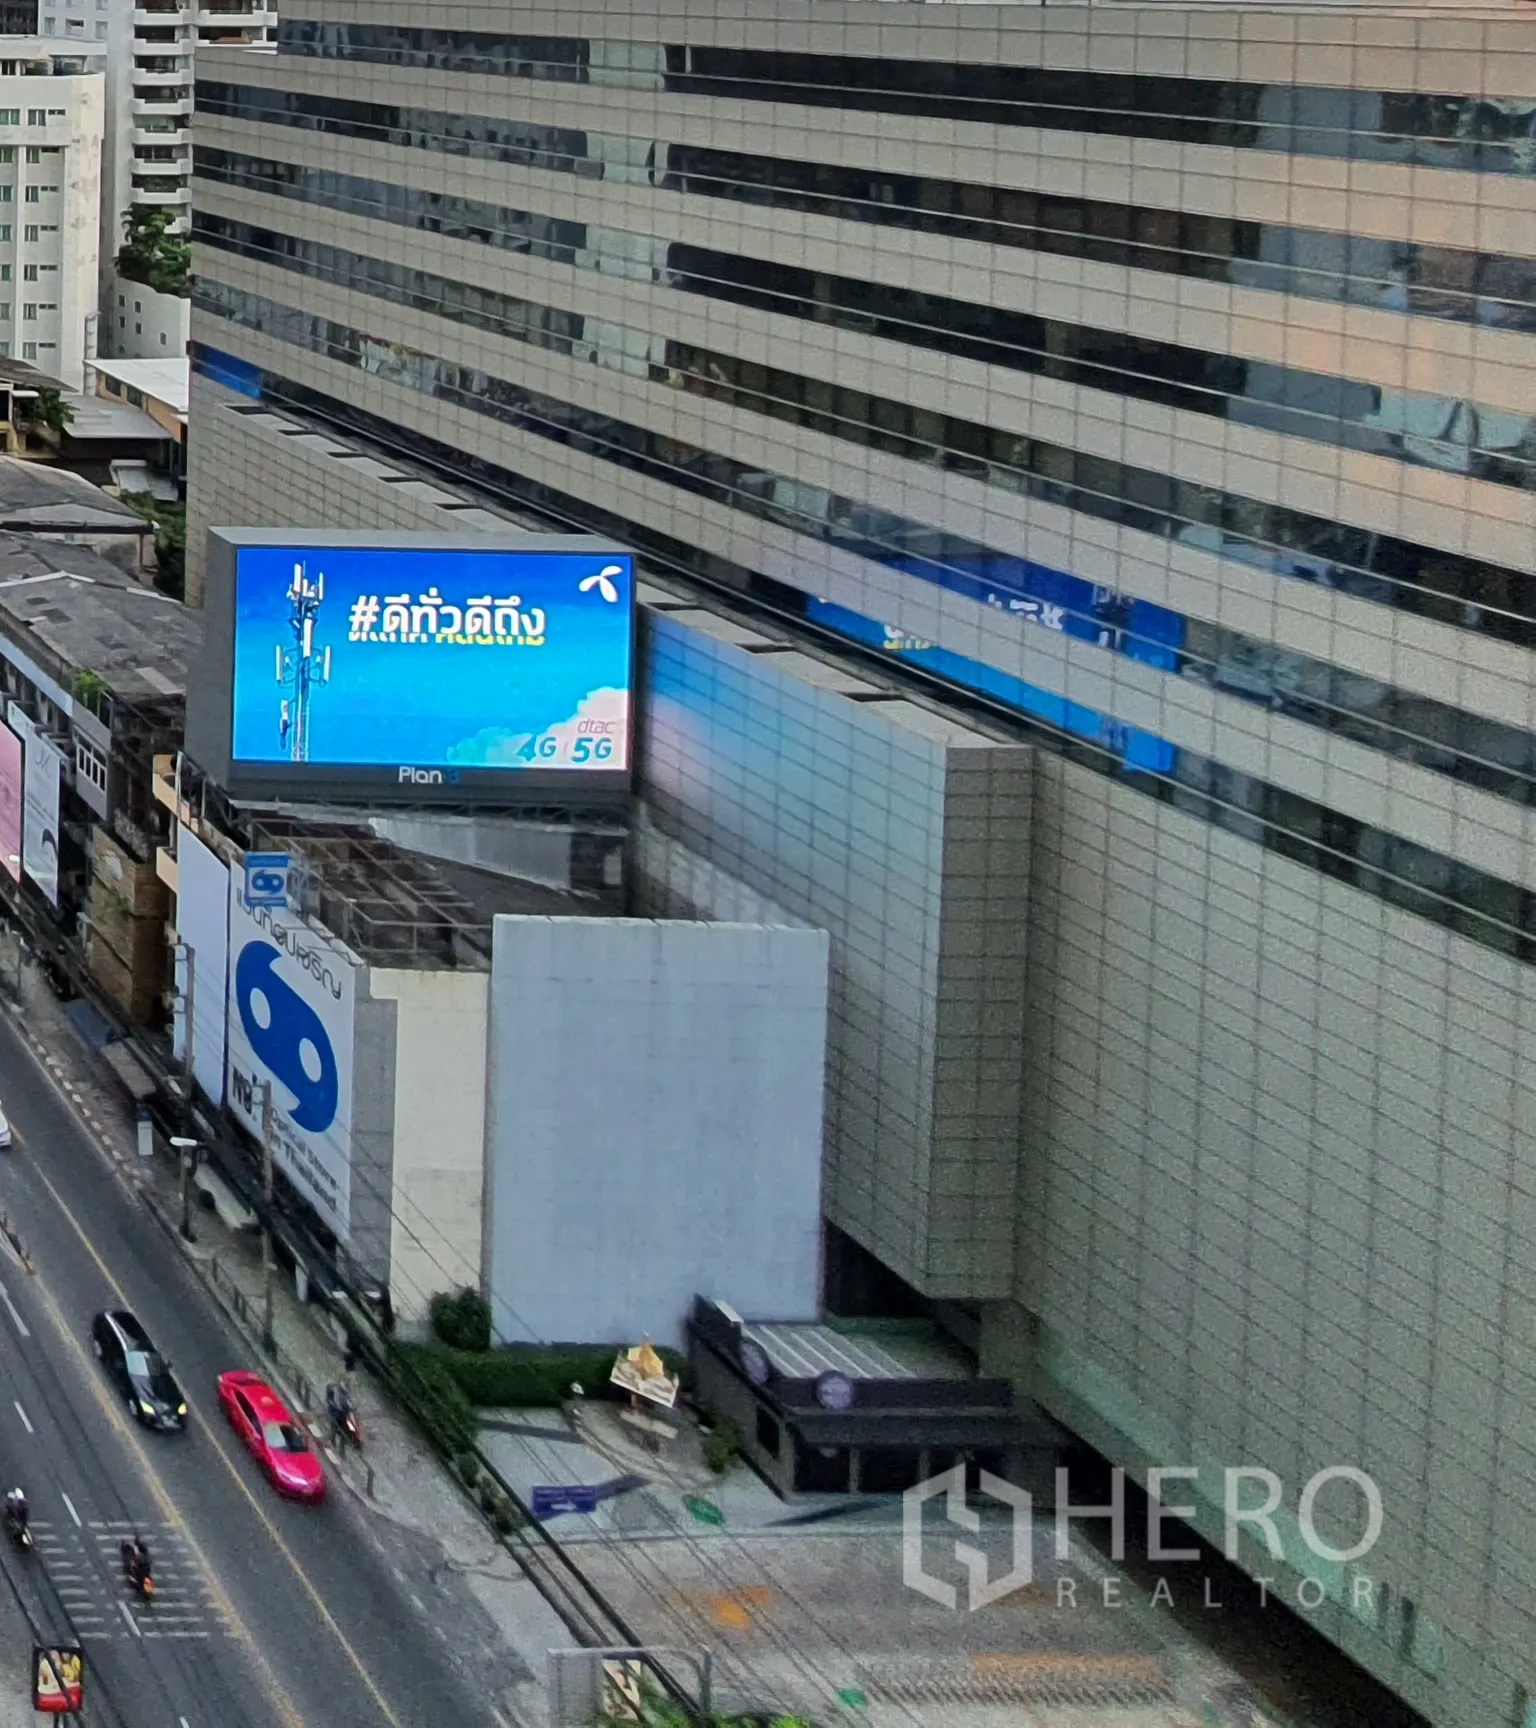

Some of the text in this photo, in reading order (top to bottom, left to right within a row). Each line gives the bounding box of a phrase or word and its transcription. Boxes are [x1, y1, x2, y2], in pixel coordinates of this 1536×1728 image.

[348, 586, 546, 637] #ดีทั่วดีถึง
[578, 718, 616, 735] dtac
[516, 734, 613, 763] 4G 5G
